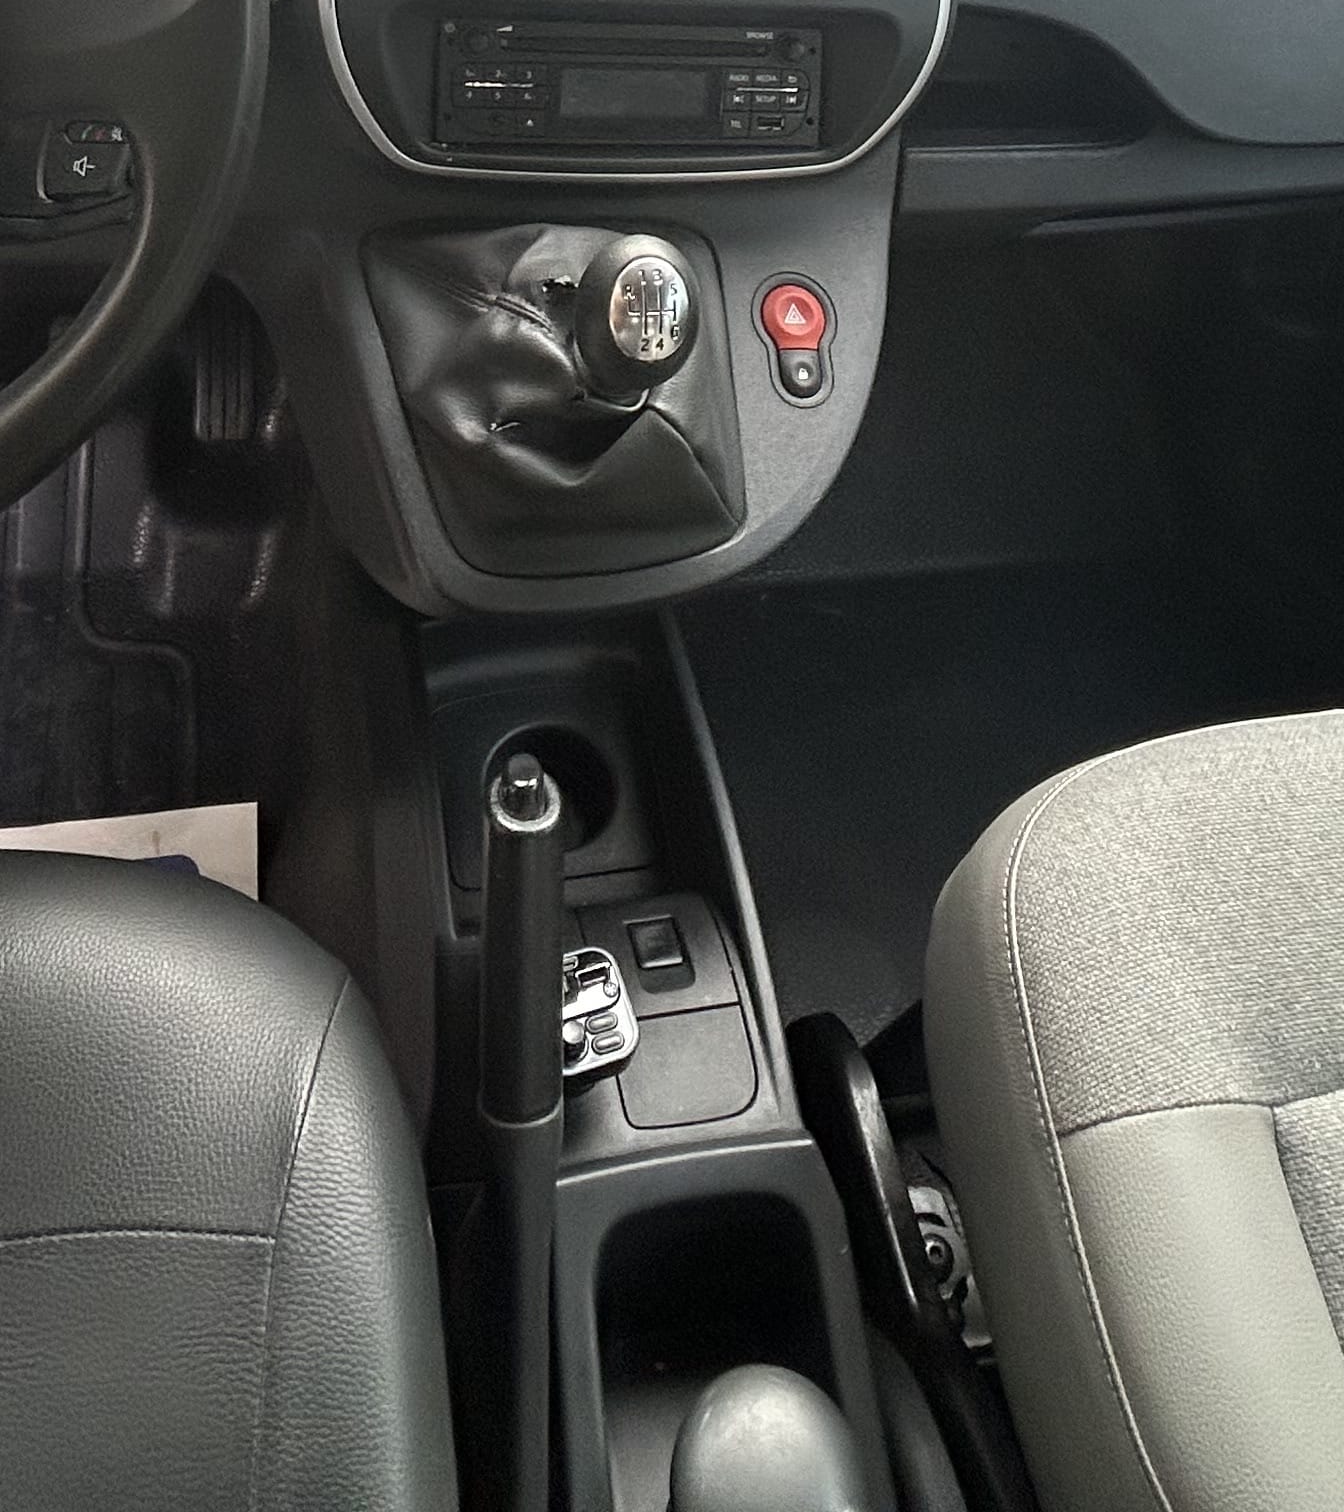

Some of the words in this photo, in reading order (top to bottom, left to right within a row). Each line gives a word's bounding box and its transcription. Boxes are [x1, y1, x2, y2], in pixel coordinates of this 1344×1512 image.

[652, 269, 664, 285] 3
[670, 283, 678, 296] 5
[640, 338, 650, 352] 2
[656, 338, 664, 351] 4
